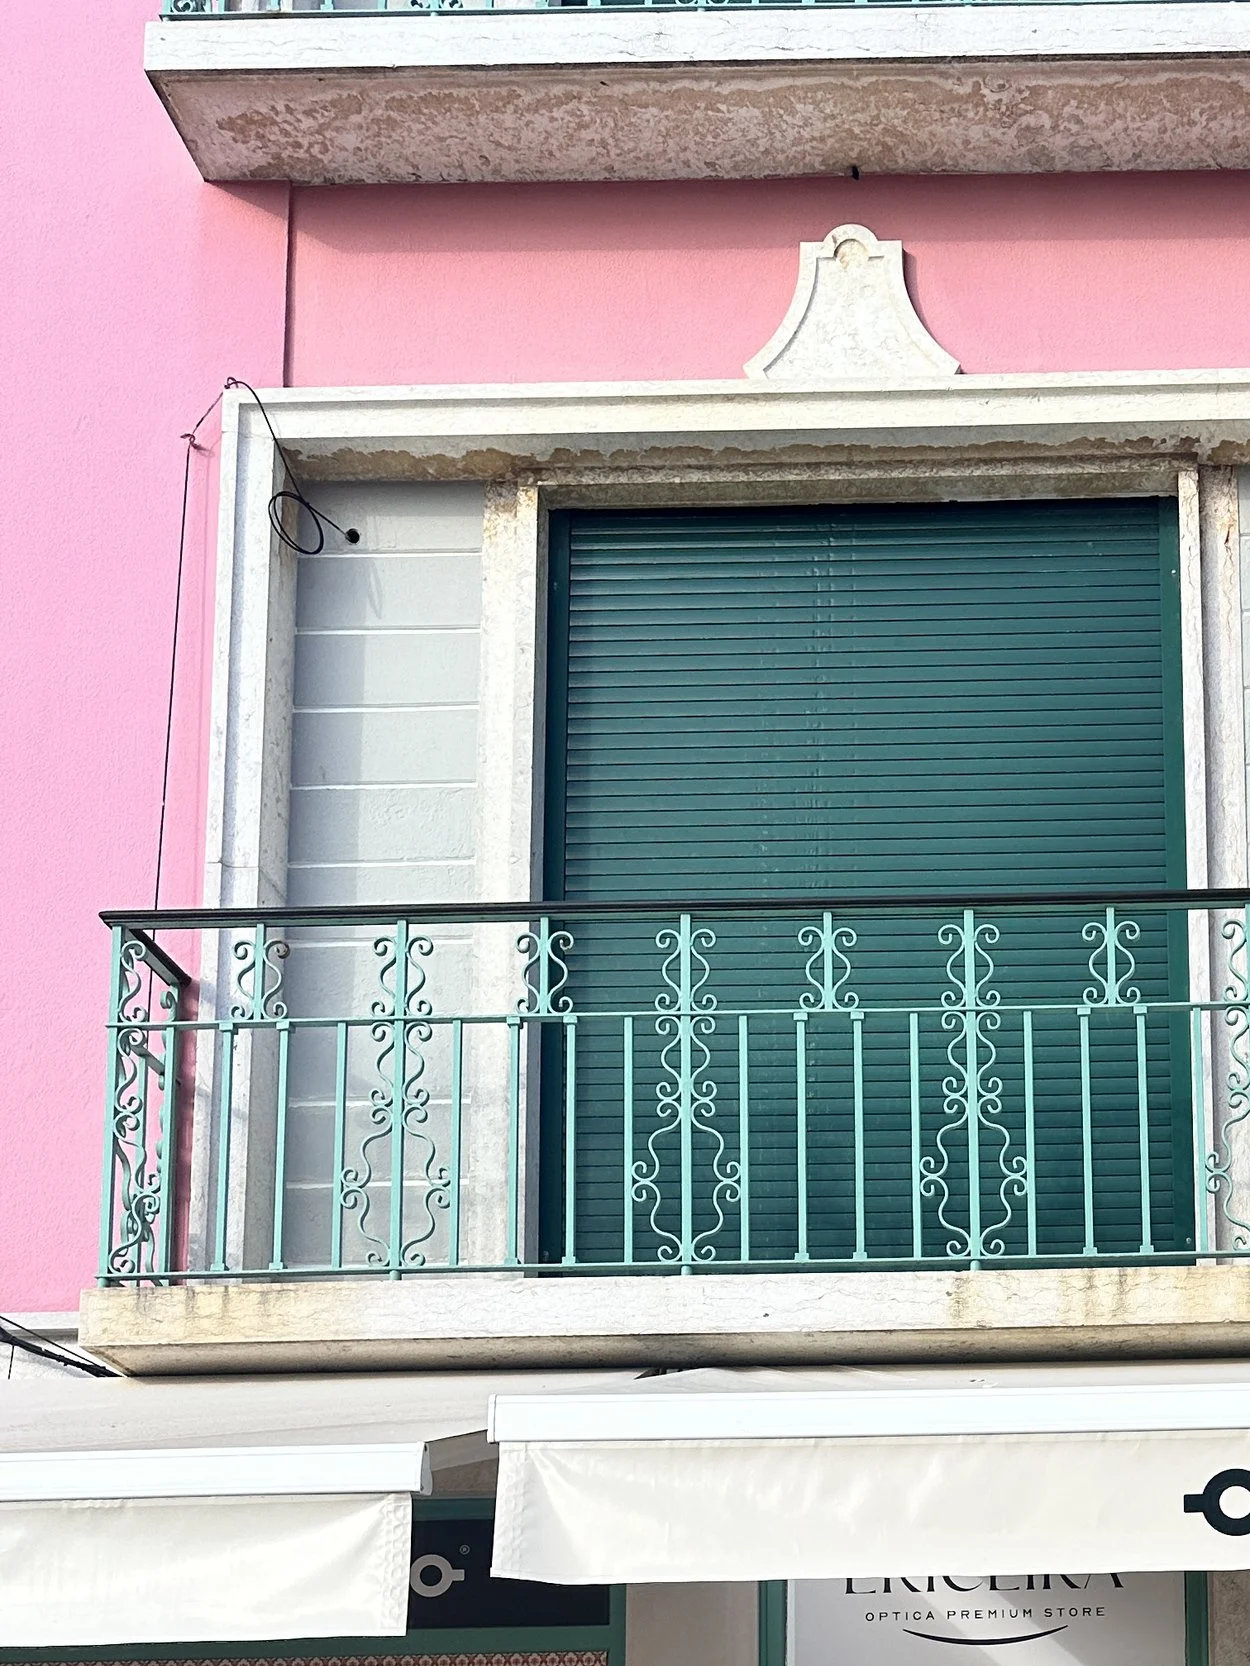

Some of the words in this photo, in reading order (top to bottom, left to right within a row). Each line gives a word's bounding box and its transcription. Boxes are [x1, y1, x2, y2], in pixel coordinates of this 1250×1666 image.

[865, 1610, 935, 1622] OPTICA
[946, 1607, 1033, 1620] PREMIUM
[1043, 1606, 1106, 1618] STORE
